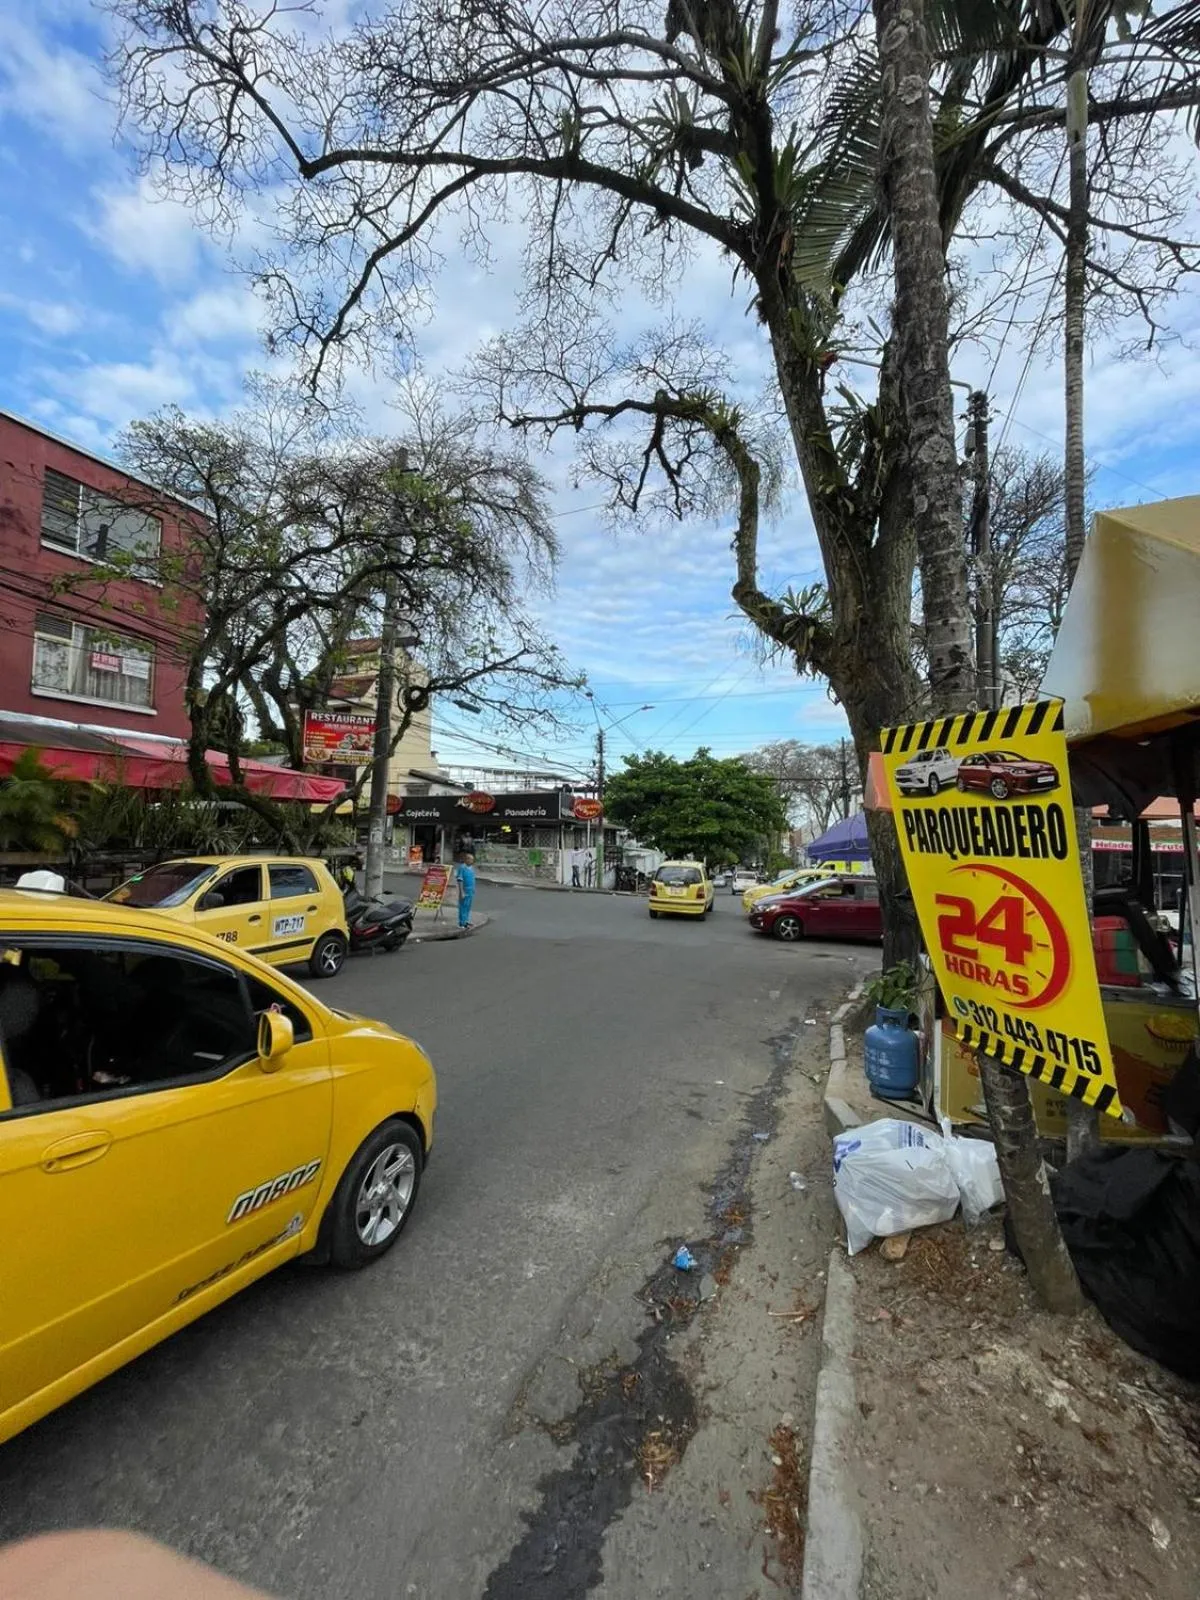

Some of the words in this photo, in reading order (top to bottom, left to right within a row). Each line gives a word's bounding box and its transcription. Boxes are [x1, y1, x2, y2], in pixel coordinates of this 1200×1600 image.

[311, 712, 376, 725] RESTAURANT
[902, 803, 1068, 860] PARQUEADERO
[934, 893, 1033, 966] 24
[945, 954, 1029, 997] HORAS
[968, 1000, 1003, 1037] 312
[1004, 1013, 1044, 1053] 443
[1046, 1029, 1102, 1076] 4715
